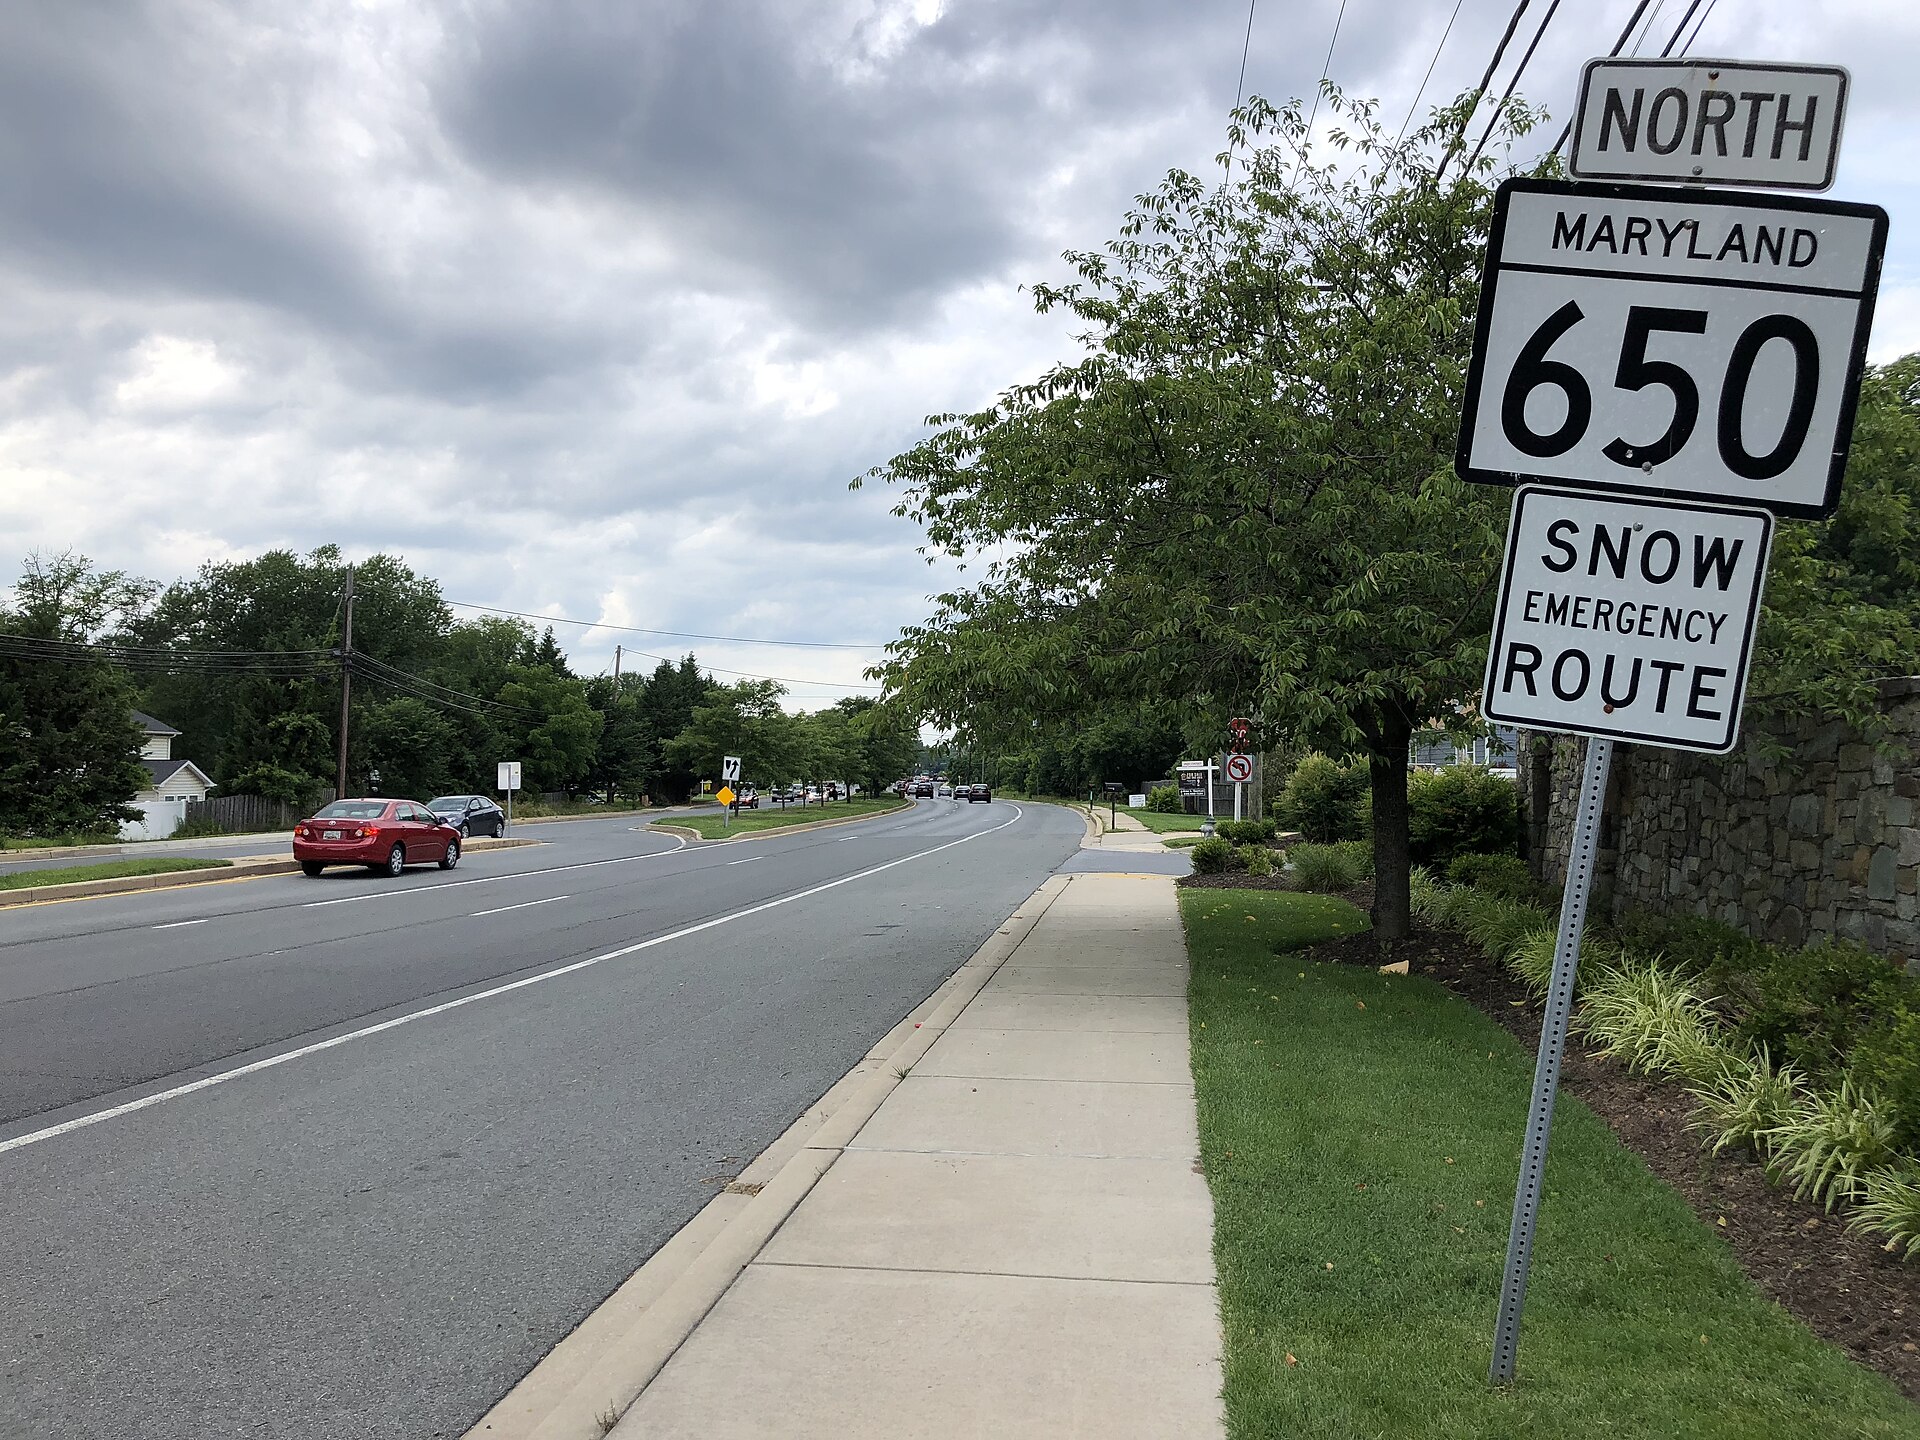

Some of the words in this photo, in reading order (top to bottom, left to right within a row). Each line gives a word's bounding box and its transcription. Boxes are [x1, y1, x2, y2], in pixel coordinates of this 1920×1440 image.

[1598, 87, 1819, 161] NORTH
[1551, 211, 1819, 268] MARYLAND
[1501, 299, 1820, 481] 650
[1541, 519, 1745, 592] SNOW
[1522, 590, 1729, 645] EMERGENCY
[1502, 641, 1728, 722] ROUTE
